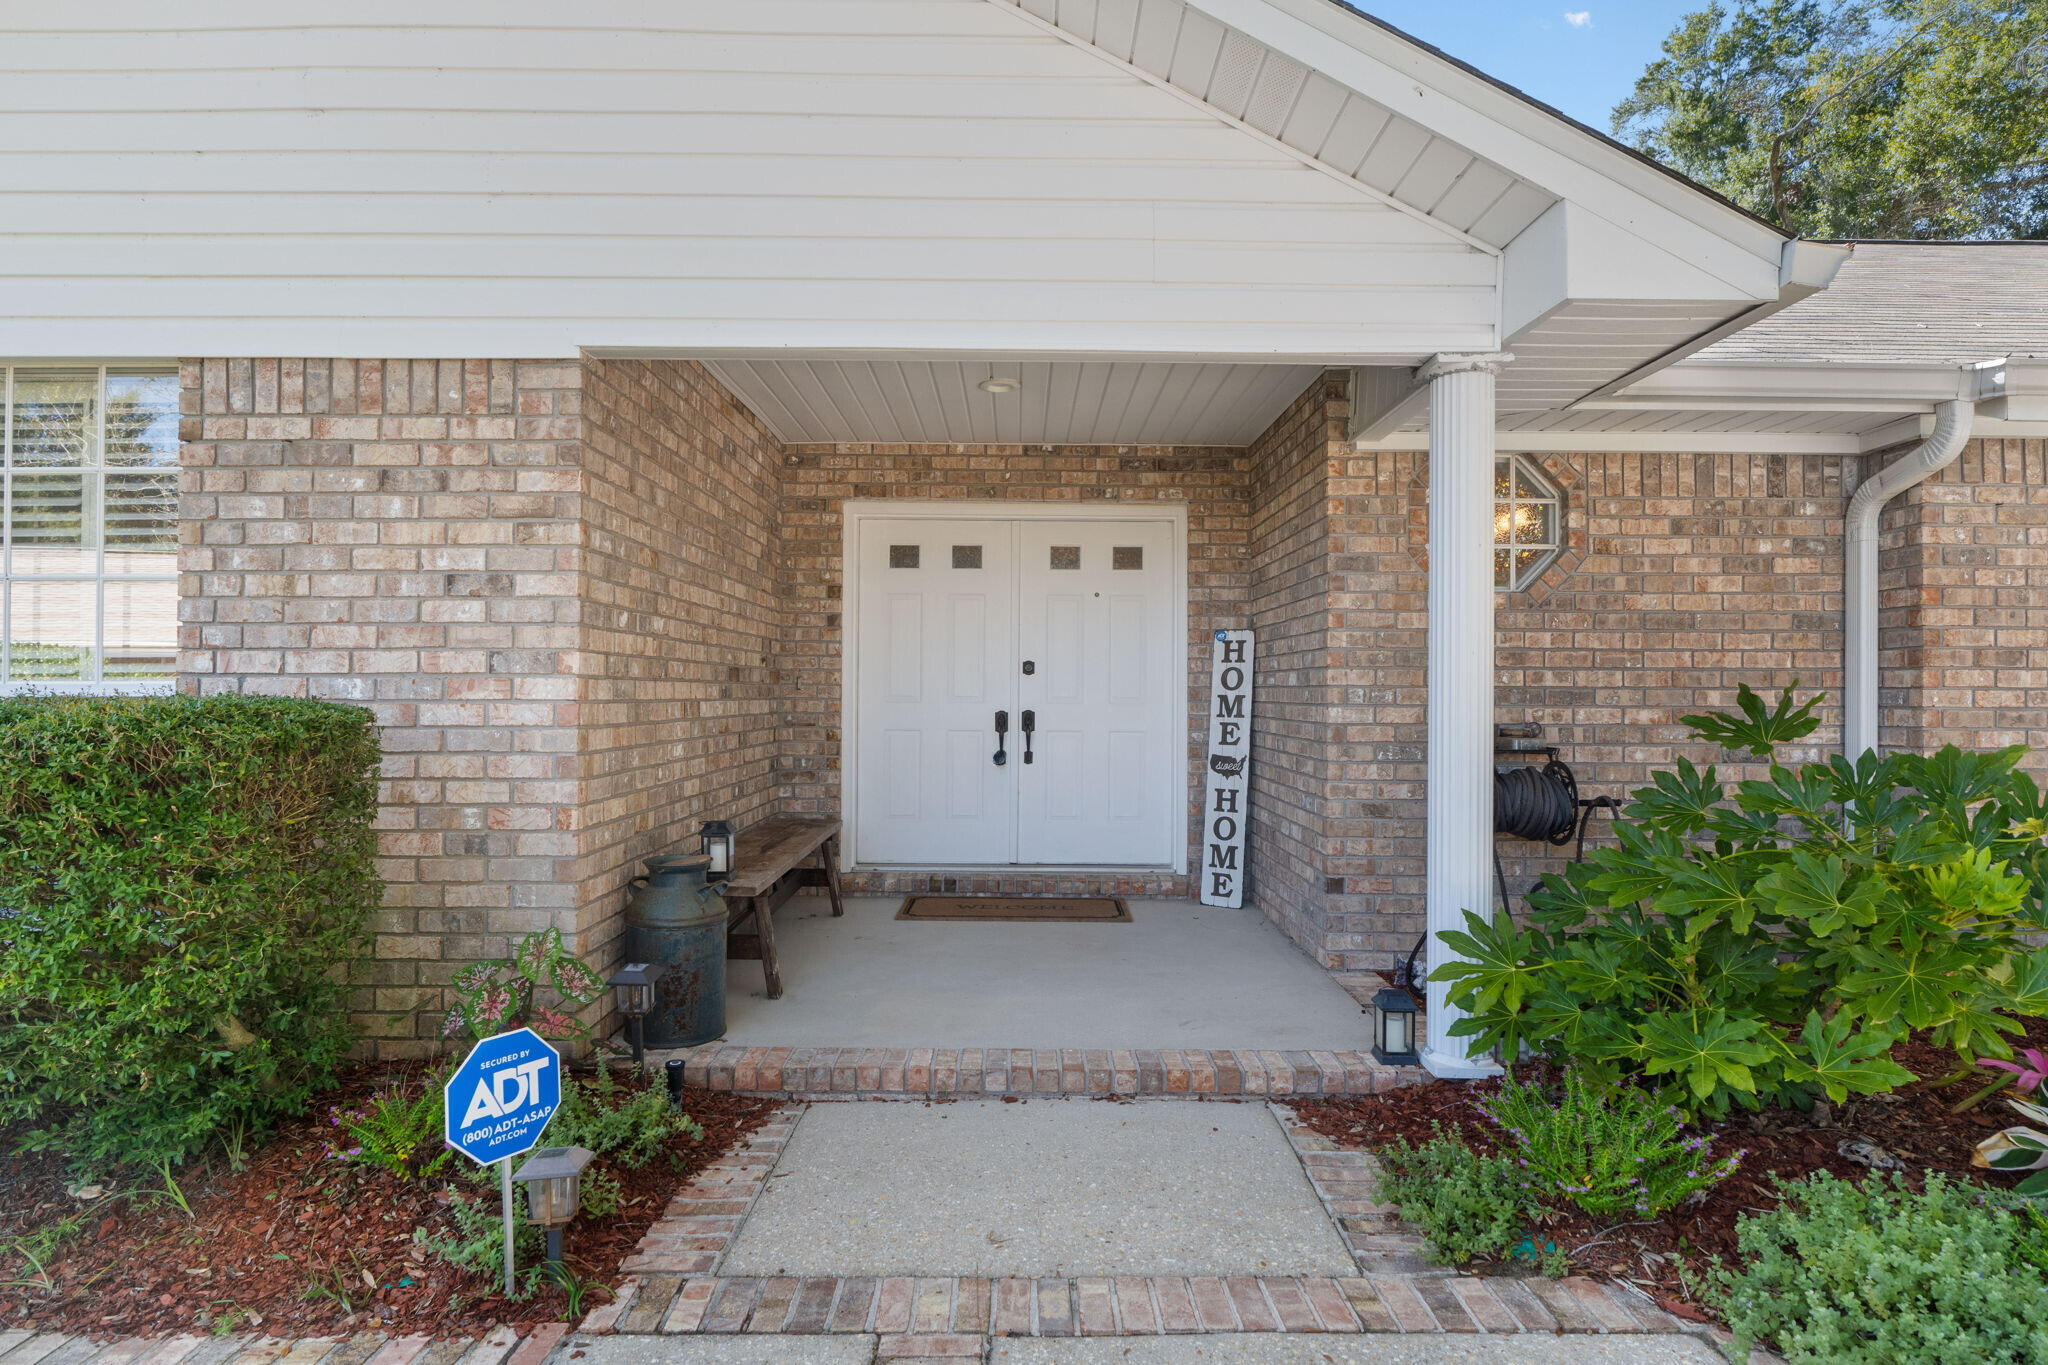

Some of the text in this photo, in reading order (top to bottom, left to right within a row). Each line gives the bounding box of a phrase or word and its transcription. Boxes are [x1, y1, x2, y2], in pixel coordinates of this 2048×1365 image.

[1216, 639, 1247, 746] HOME
[1208, 788, 1239, 898] HOME
[956, 903, 1081, 911] WELCOME
[480, 1049, 530, 1070] SECURED BY
[460, 1056, 549, 1129] ADT
[462, 1106, 552, 1146] (800) ADT-ASAP
[489, 1127, 528, 1147] ADT.COM
